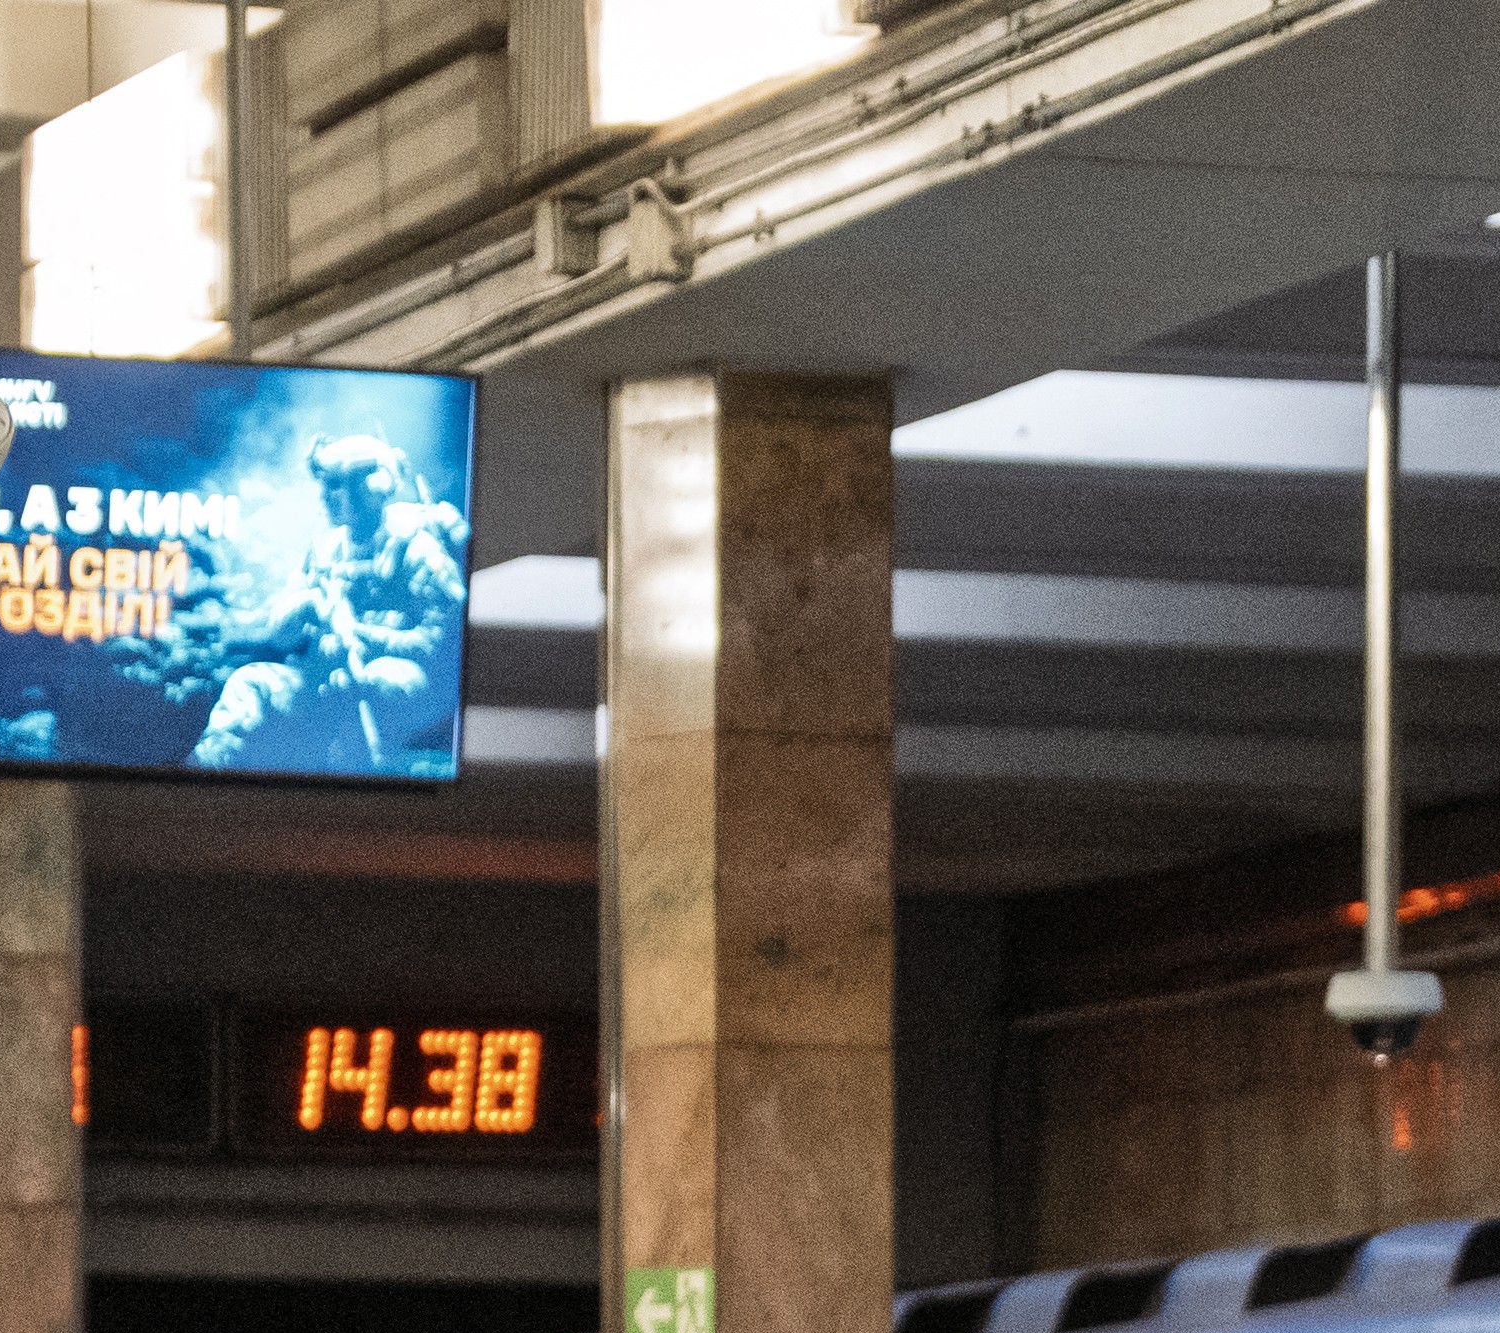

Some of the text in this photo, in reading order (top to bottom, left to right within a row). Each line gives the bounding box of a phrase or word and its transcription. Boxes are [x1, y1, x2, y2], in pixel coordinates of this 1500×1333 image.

[21, 484, 60, 533] А
[69, 539, 191, 597] СВІЙ
[299, 1027, 542, 1133] 14.38
